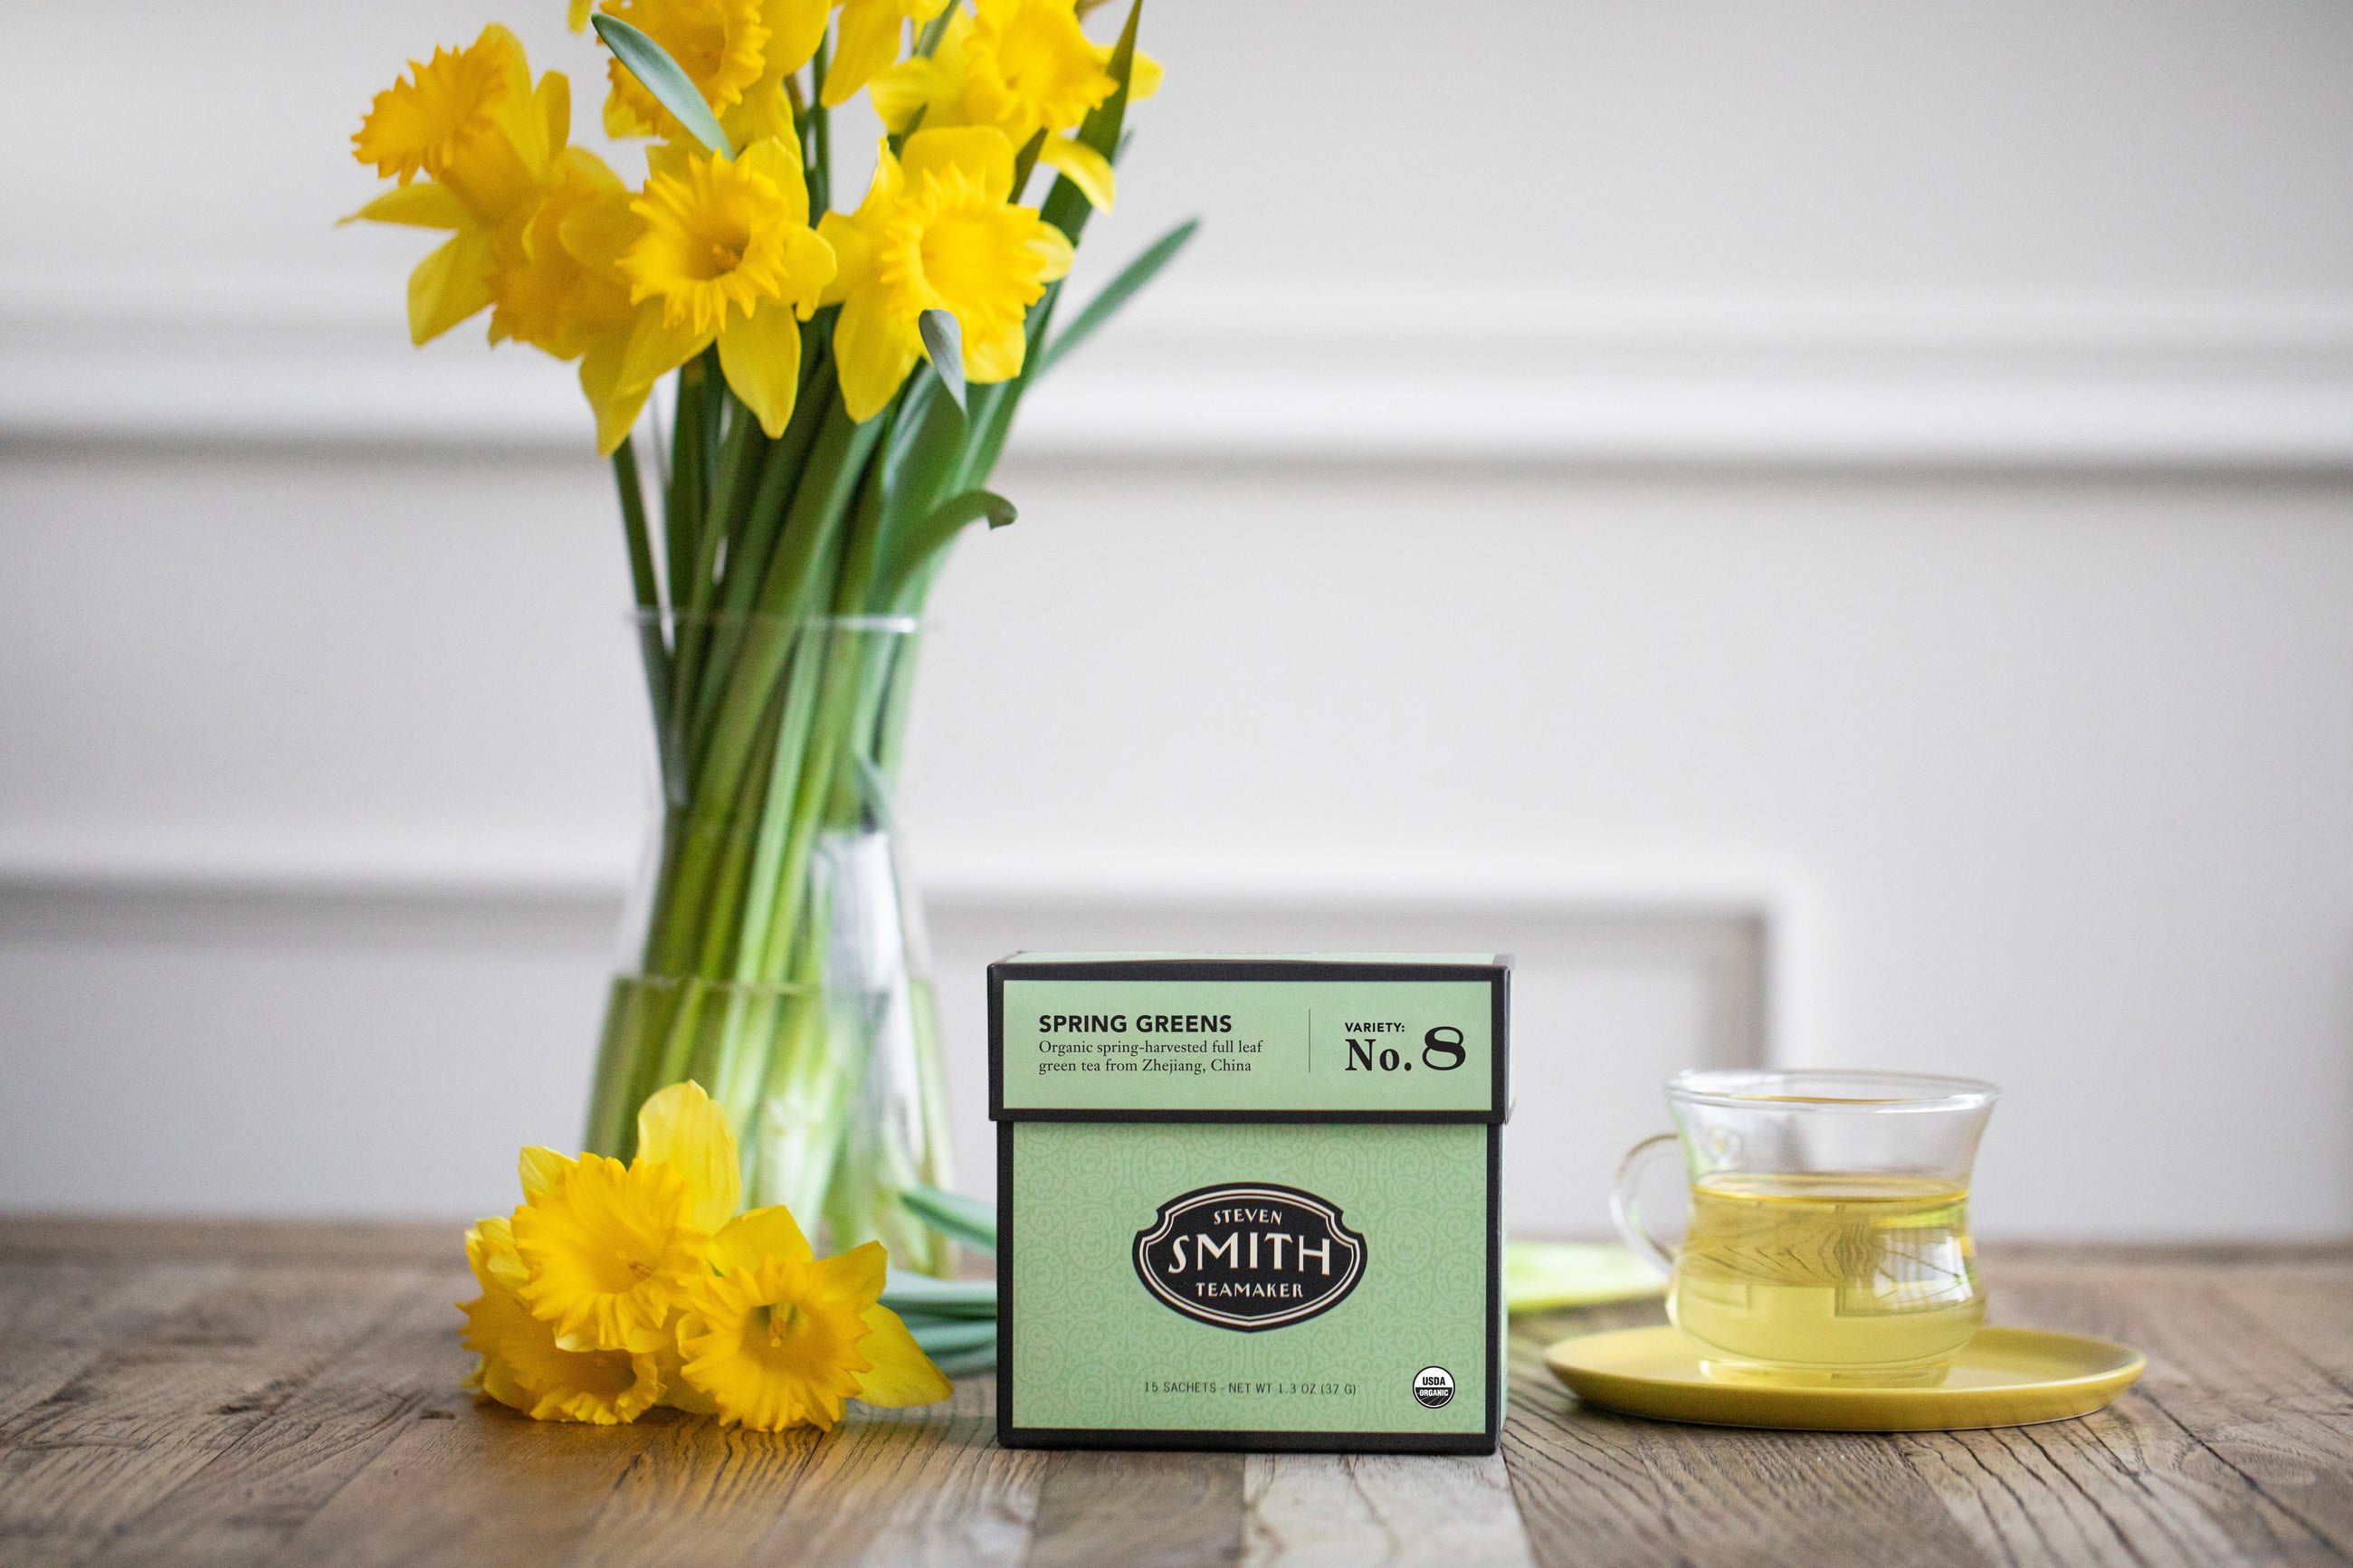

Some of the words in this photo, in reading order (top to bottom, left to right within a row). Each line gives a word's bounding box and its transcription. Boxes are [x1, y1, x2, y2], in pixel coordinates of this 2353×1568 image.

[1039, 1015, 1127, 1032] SPRING
[1136, 1015, 1232, 1032] GREENS
[1345, 1022, 1405, 1032] VARIETY:
[1039, 1041, 1093, 1056] Organic
[1097, 1041, 1207, 1056] spring-harvested
[1212, 1041, 1234, 1052] full
[1238, 1041, 1263, 1052] leaf
[1345, 1039, 1412, 1071] No.
[1422, 1026, 1466, 1071] 8
[1039, 1062, 1076, 1075] green
[1081, 1061, 1100, 1071] tea
[1106, 1059, 1138, 1071] from
[1142, 1059, 1206, 1075] Zhejiang,
[1211, 1059, 1252, 1071] China
[1214, 1209, 1282, 1225] STEVEN
[1167, 1232, 1330, 1276] SMITH
[1196, 1283, 1303, 1298] TEAMAKER
[1144, 1382, 1158, 1392] 15
[1163, 1382, 1216, 1393] SACHETS
[1228, 1383, 1251, 1393] NET
[1255, 1383, 1272, 1393] WT
[1278, 1383, 1296, 1394] 1.3
[1300, 1383, 1316, 1394] OZ
[1320, 1383, 1339, 1395] (37
[1344, 1383, 1357, 1395] G)
[1422, 1377, 1445, 1385] USDA
[1419, 1389, 1449, 1397] ORGANIC
